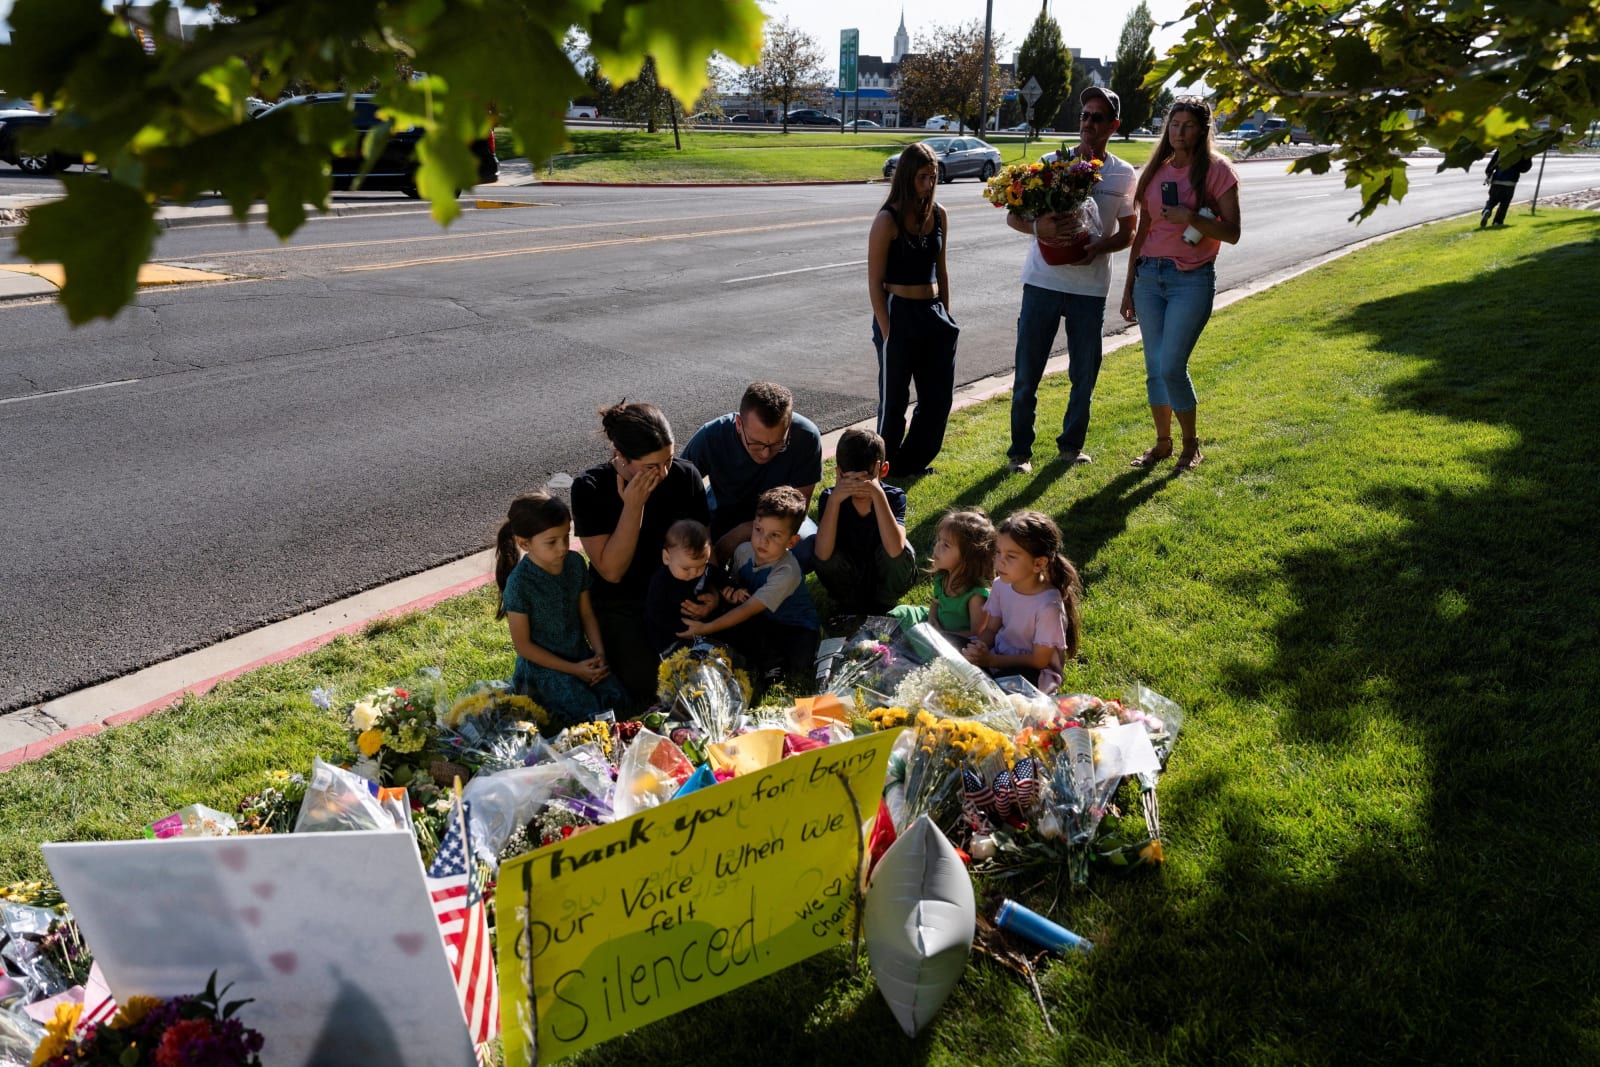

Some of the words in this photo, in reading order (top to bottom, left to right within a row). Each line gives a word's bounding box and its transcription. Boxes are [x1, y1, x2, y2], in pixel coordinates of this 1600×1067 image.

[508, 816, 654, 888] Thank
[672, 802, 733, 856] you
[752, 774, 794, 802] for
[809, 748, 876, 783] being
[514, 911, 593, 960] Our
[621, 876, 692, 918] Voice
[715, 837, 783, 878] When
[801, 813, 843, 842] We
[645, 901, 696, 935] felt
[795, 899, 825, 920] We
